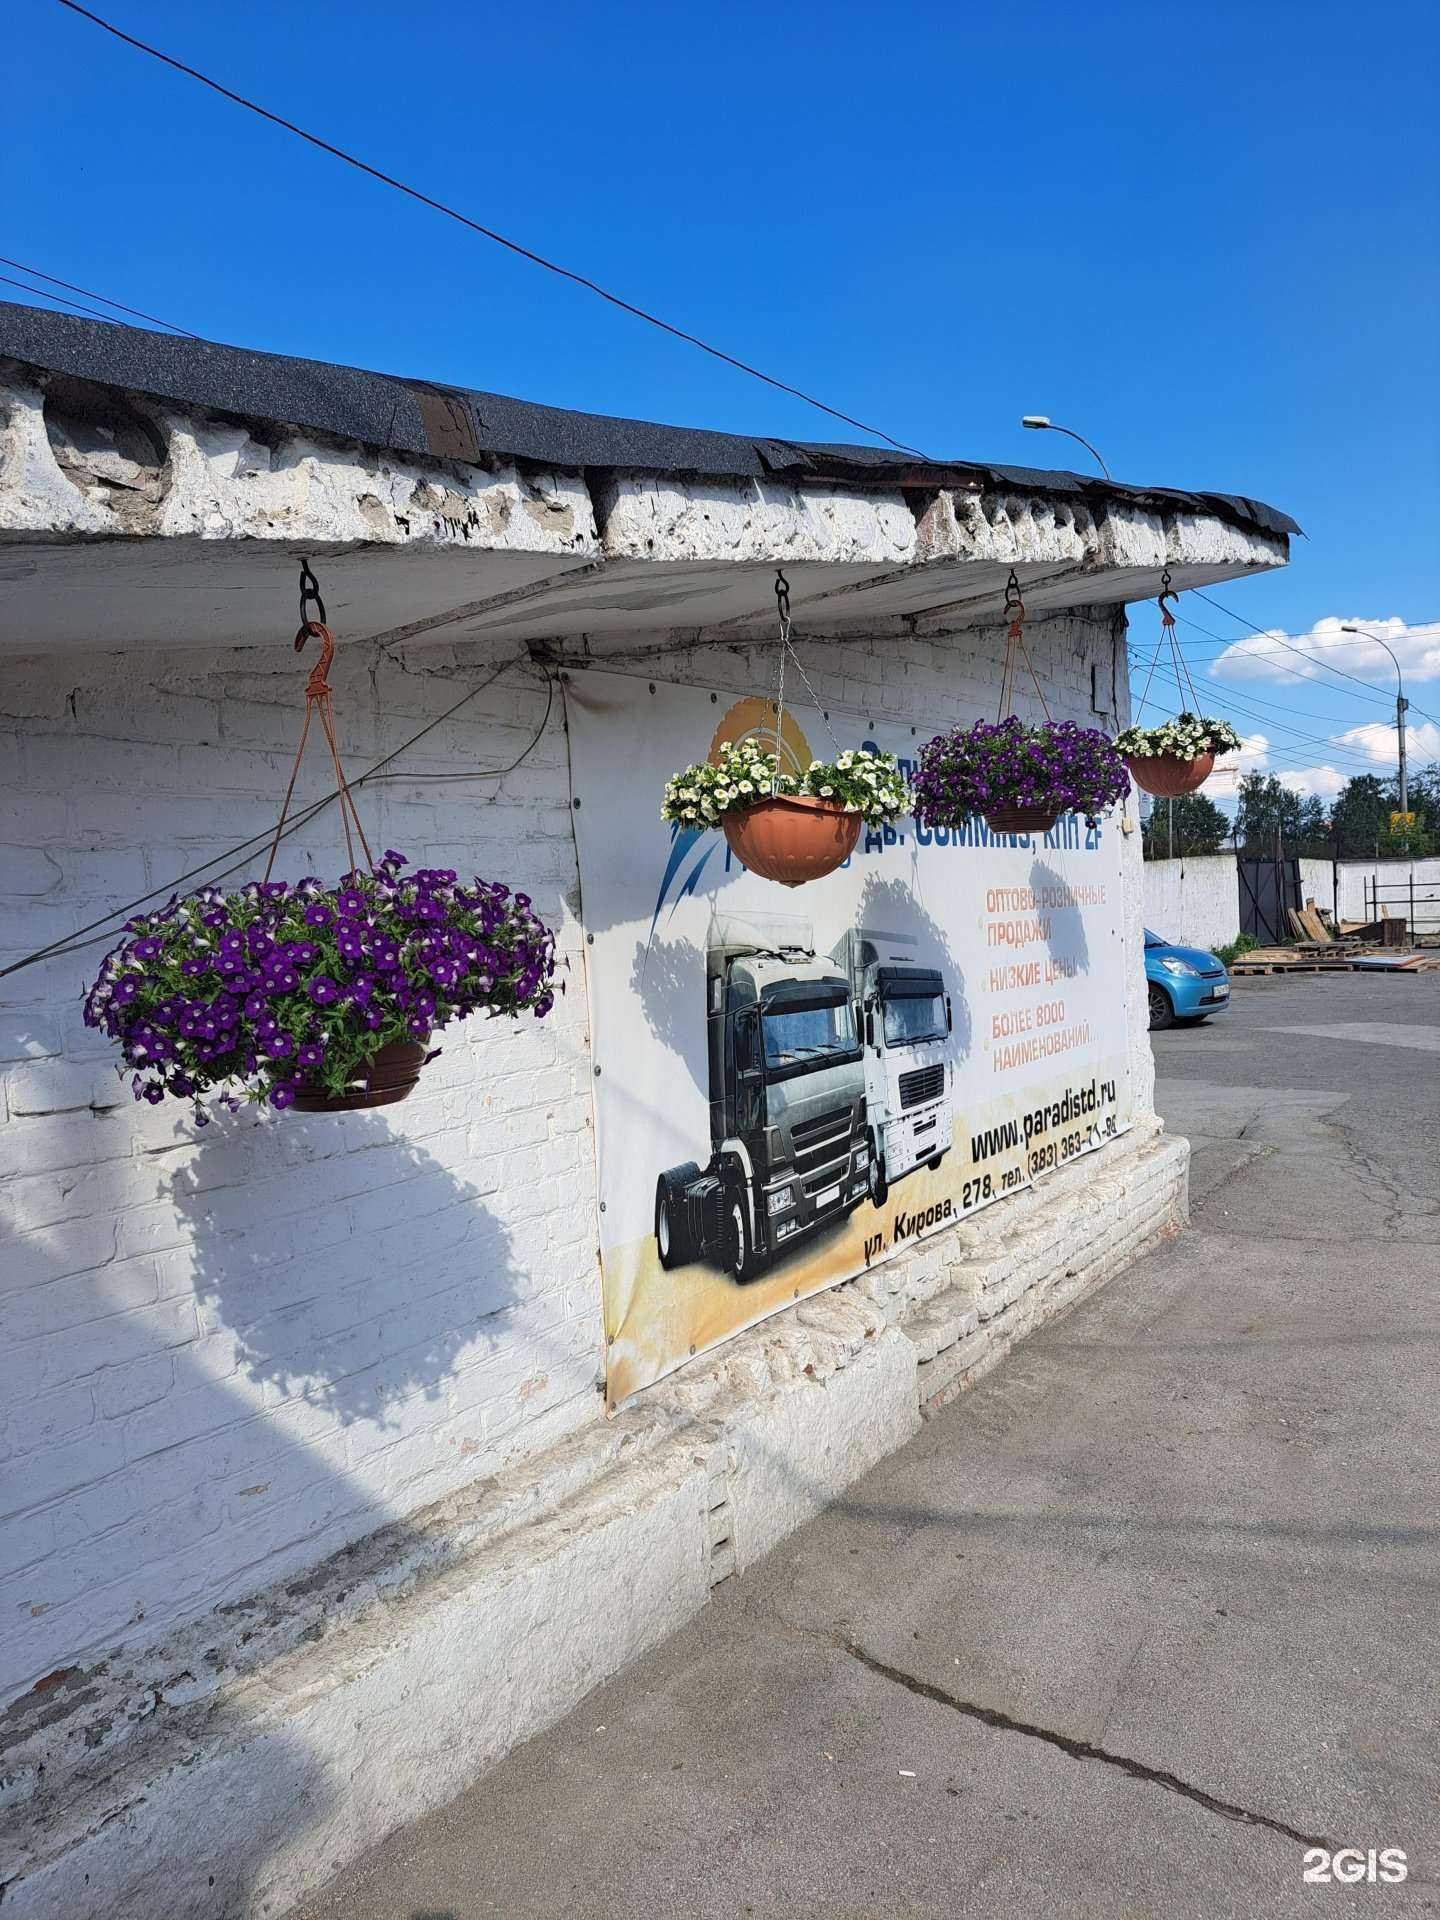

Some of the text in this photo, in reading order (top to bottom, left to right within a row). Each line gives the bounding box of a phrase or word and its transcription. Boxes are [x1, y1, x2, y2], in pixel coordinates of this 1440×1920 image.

[986, 885, 1106, 913] ОПТОВО-РОЗНИЧНЫЕ
[987, 917, 1052, 949] ПРОДАЖИ
[990, 957, 1077, 992] НИЗКИЕ ЦЕНЫ
[992, 1000, 1065, 1040] БОЛЕЕ 8000
[971, 1078, 1116, 1164] www.paradistd.ru
[864, 1232, 887, 1268] ул.
[893, 1198, 958, 1244] Кирова,
[962, 1173, 997, 1210] 278,
[1001, 1166, 1025, 1191] тел.
[1027, 1142, 1059, 1181] (383)
